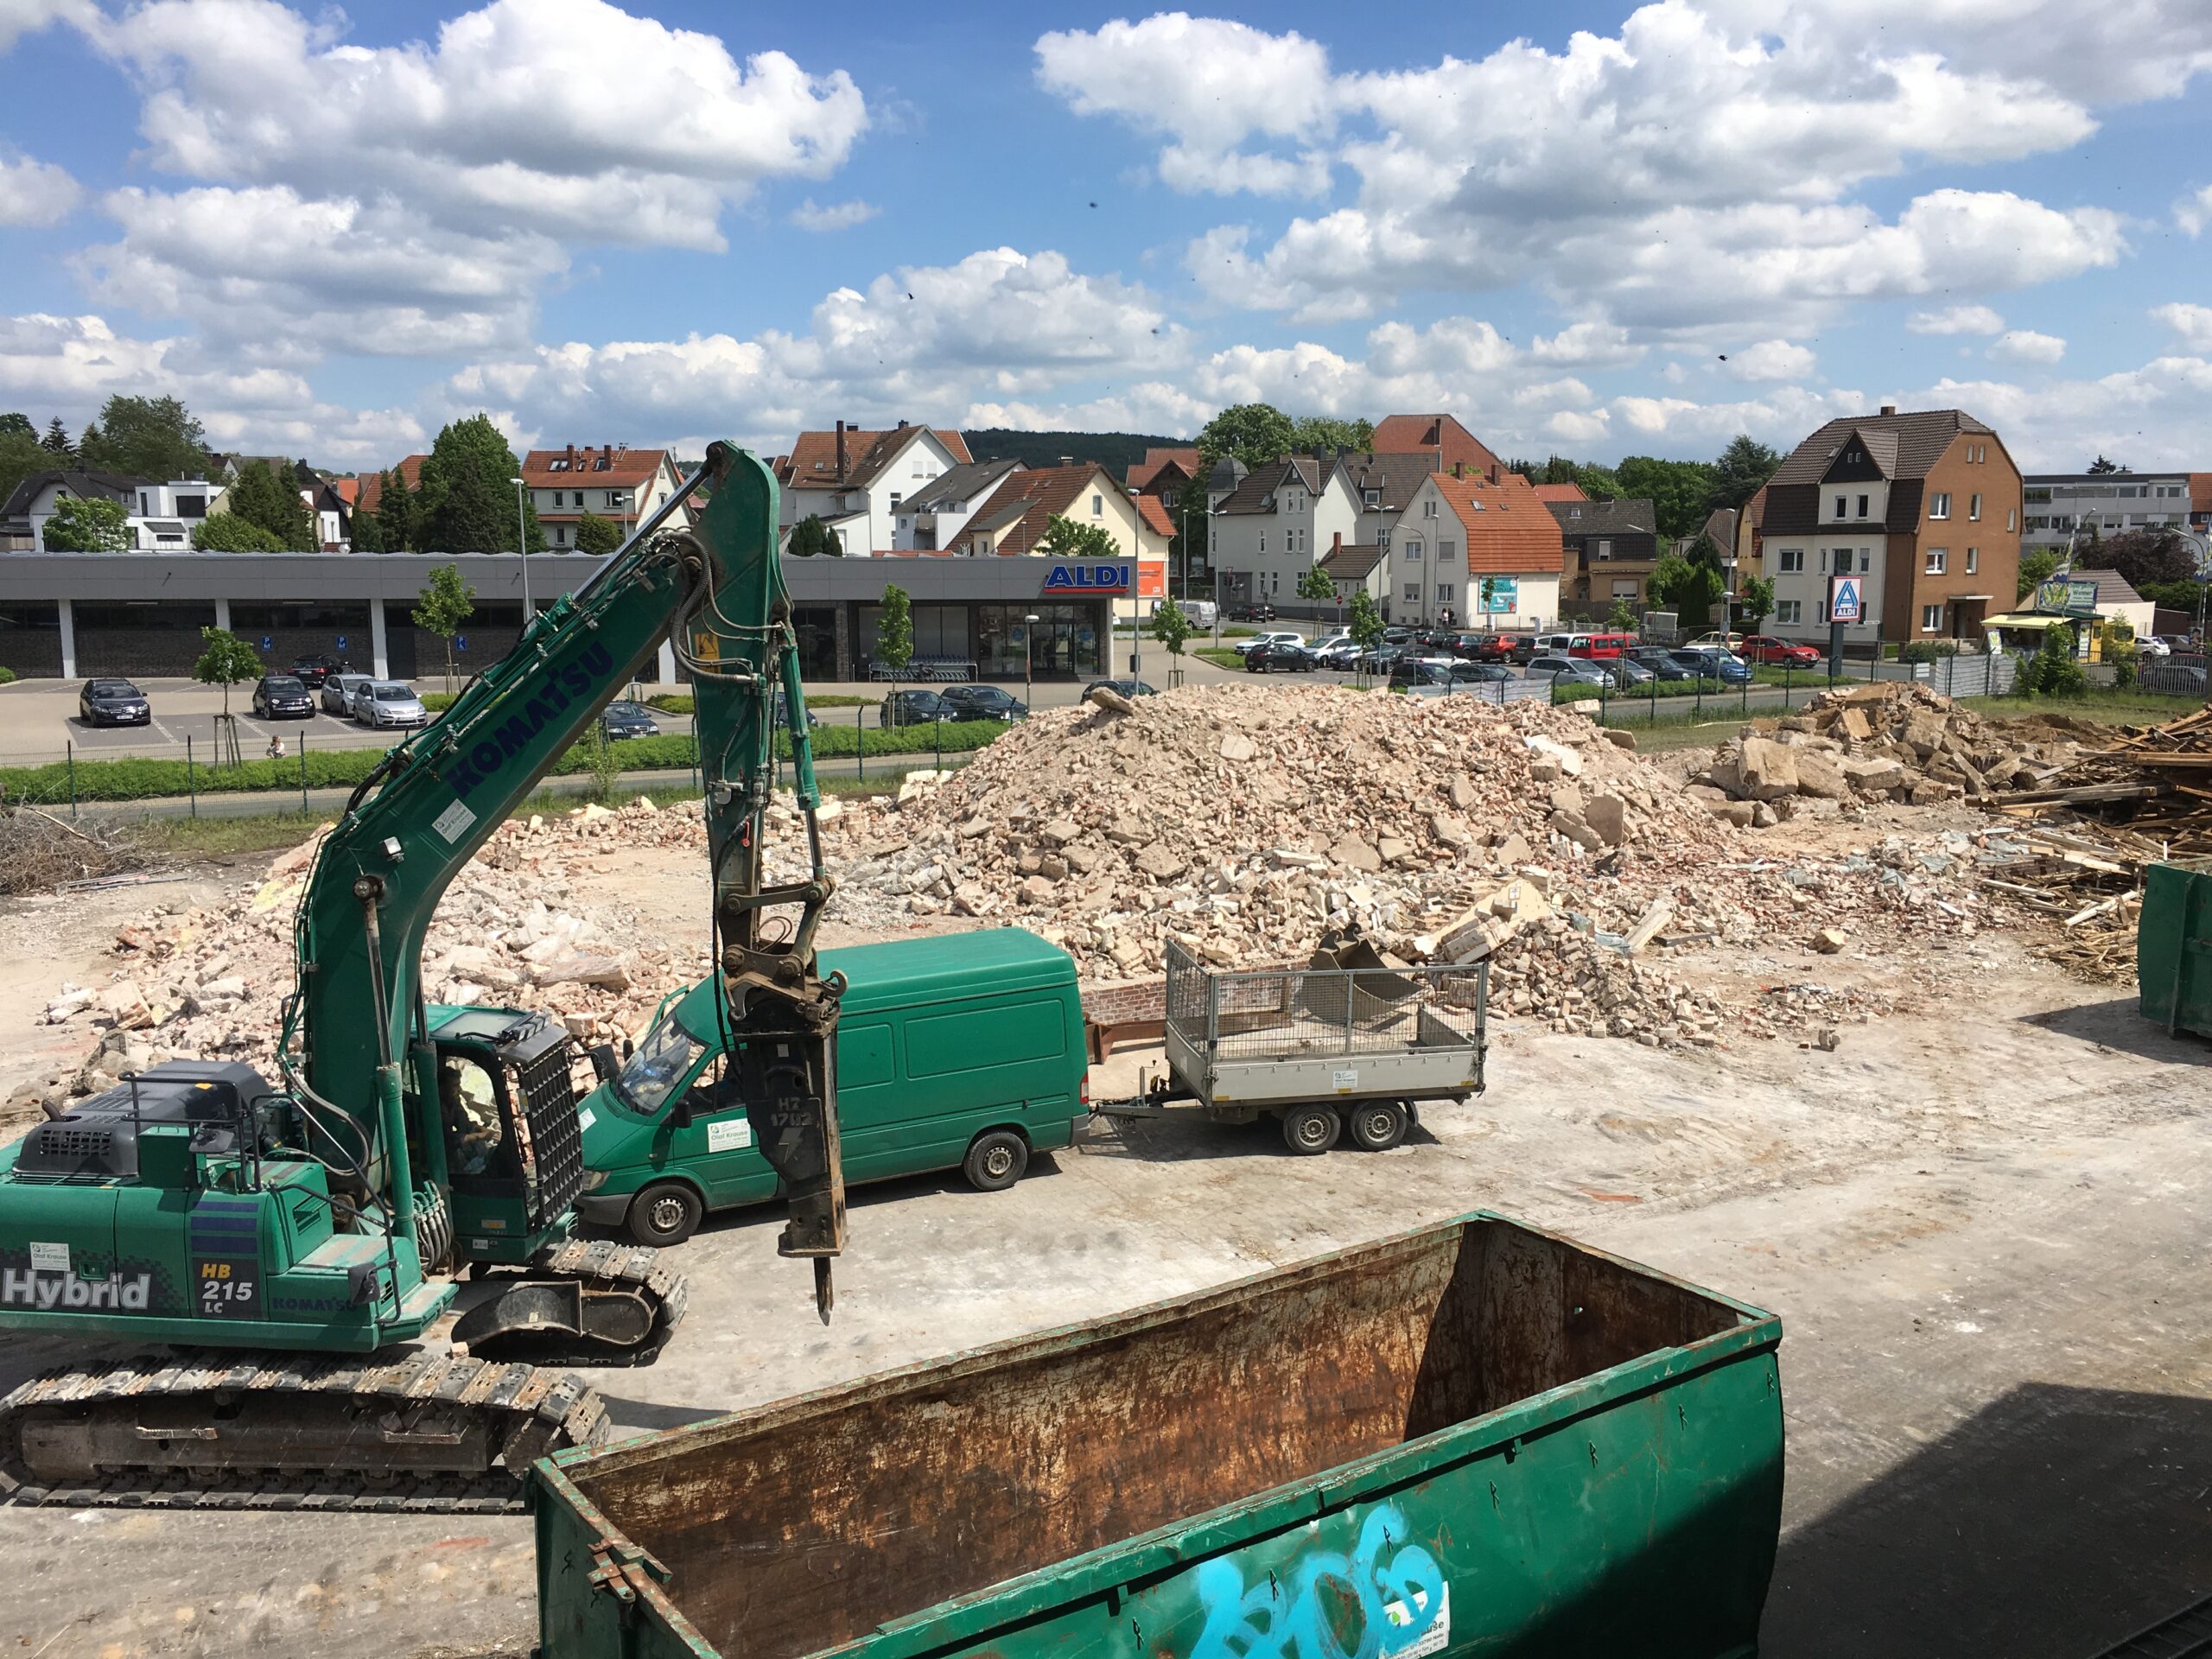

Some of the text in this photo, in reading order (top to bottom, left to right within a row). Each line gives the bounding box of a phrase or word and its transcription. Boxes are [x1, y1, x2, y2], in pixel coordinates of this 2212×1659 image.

[1045, 565, 1130, 587] ALDI
[447, 639, 613, 798] KOMATSU
[201, 1263, 232, 1279] HB
[3, 1268, 152, 1310] Hybrid
[202, 1281, 253, 1301] 215
[204, 1301, 224, 1314] LC
